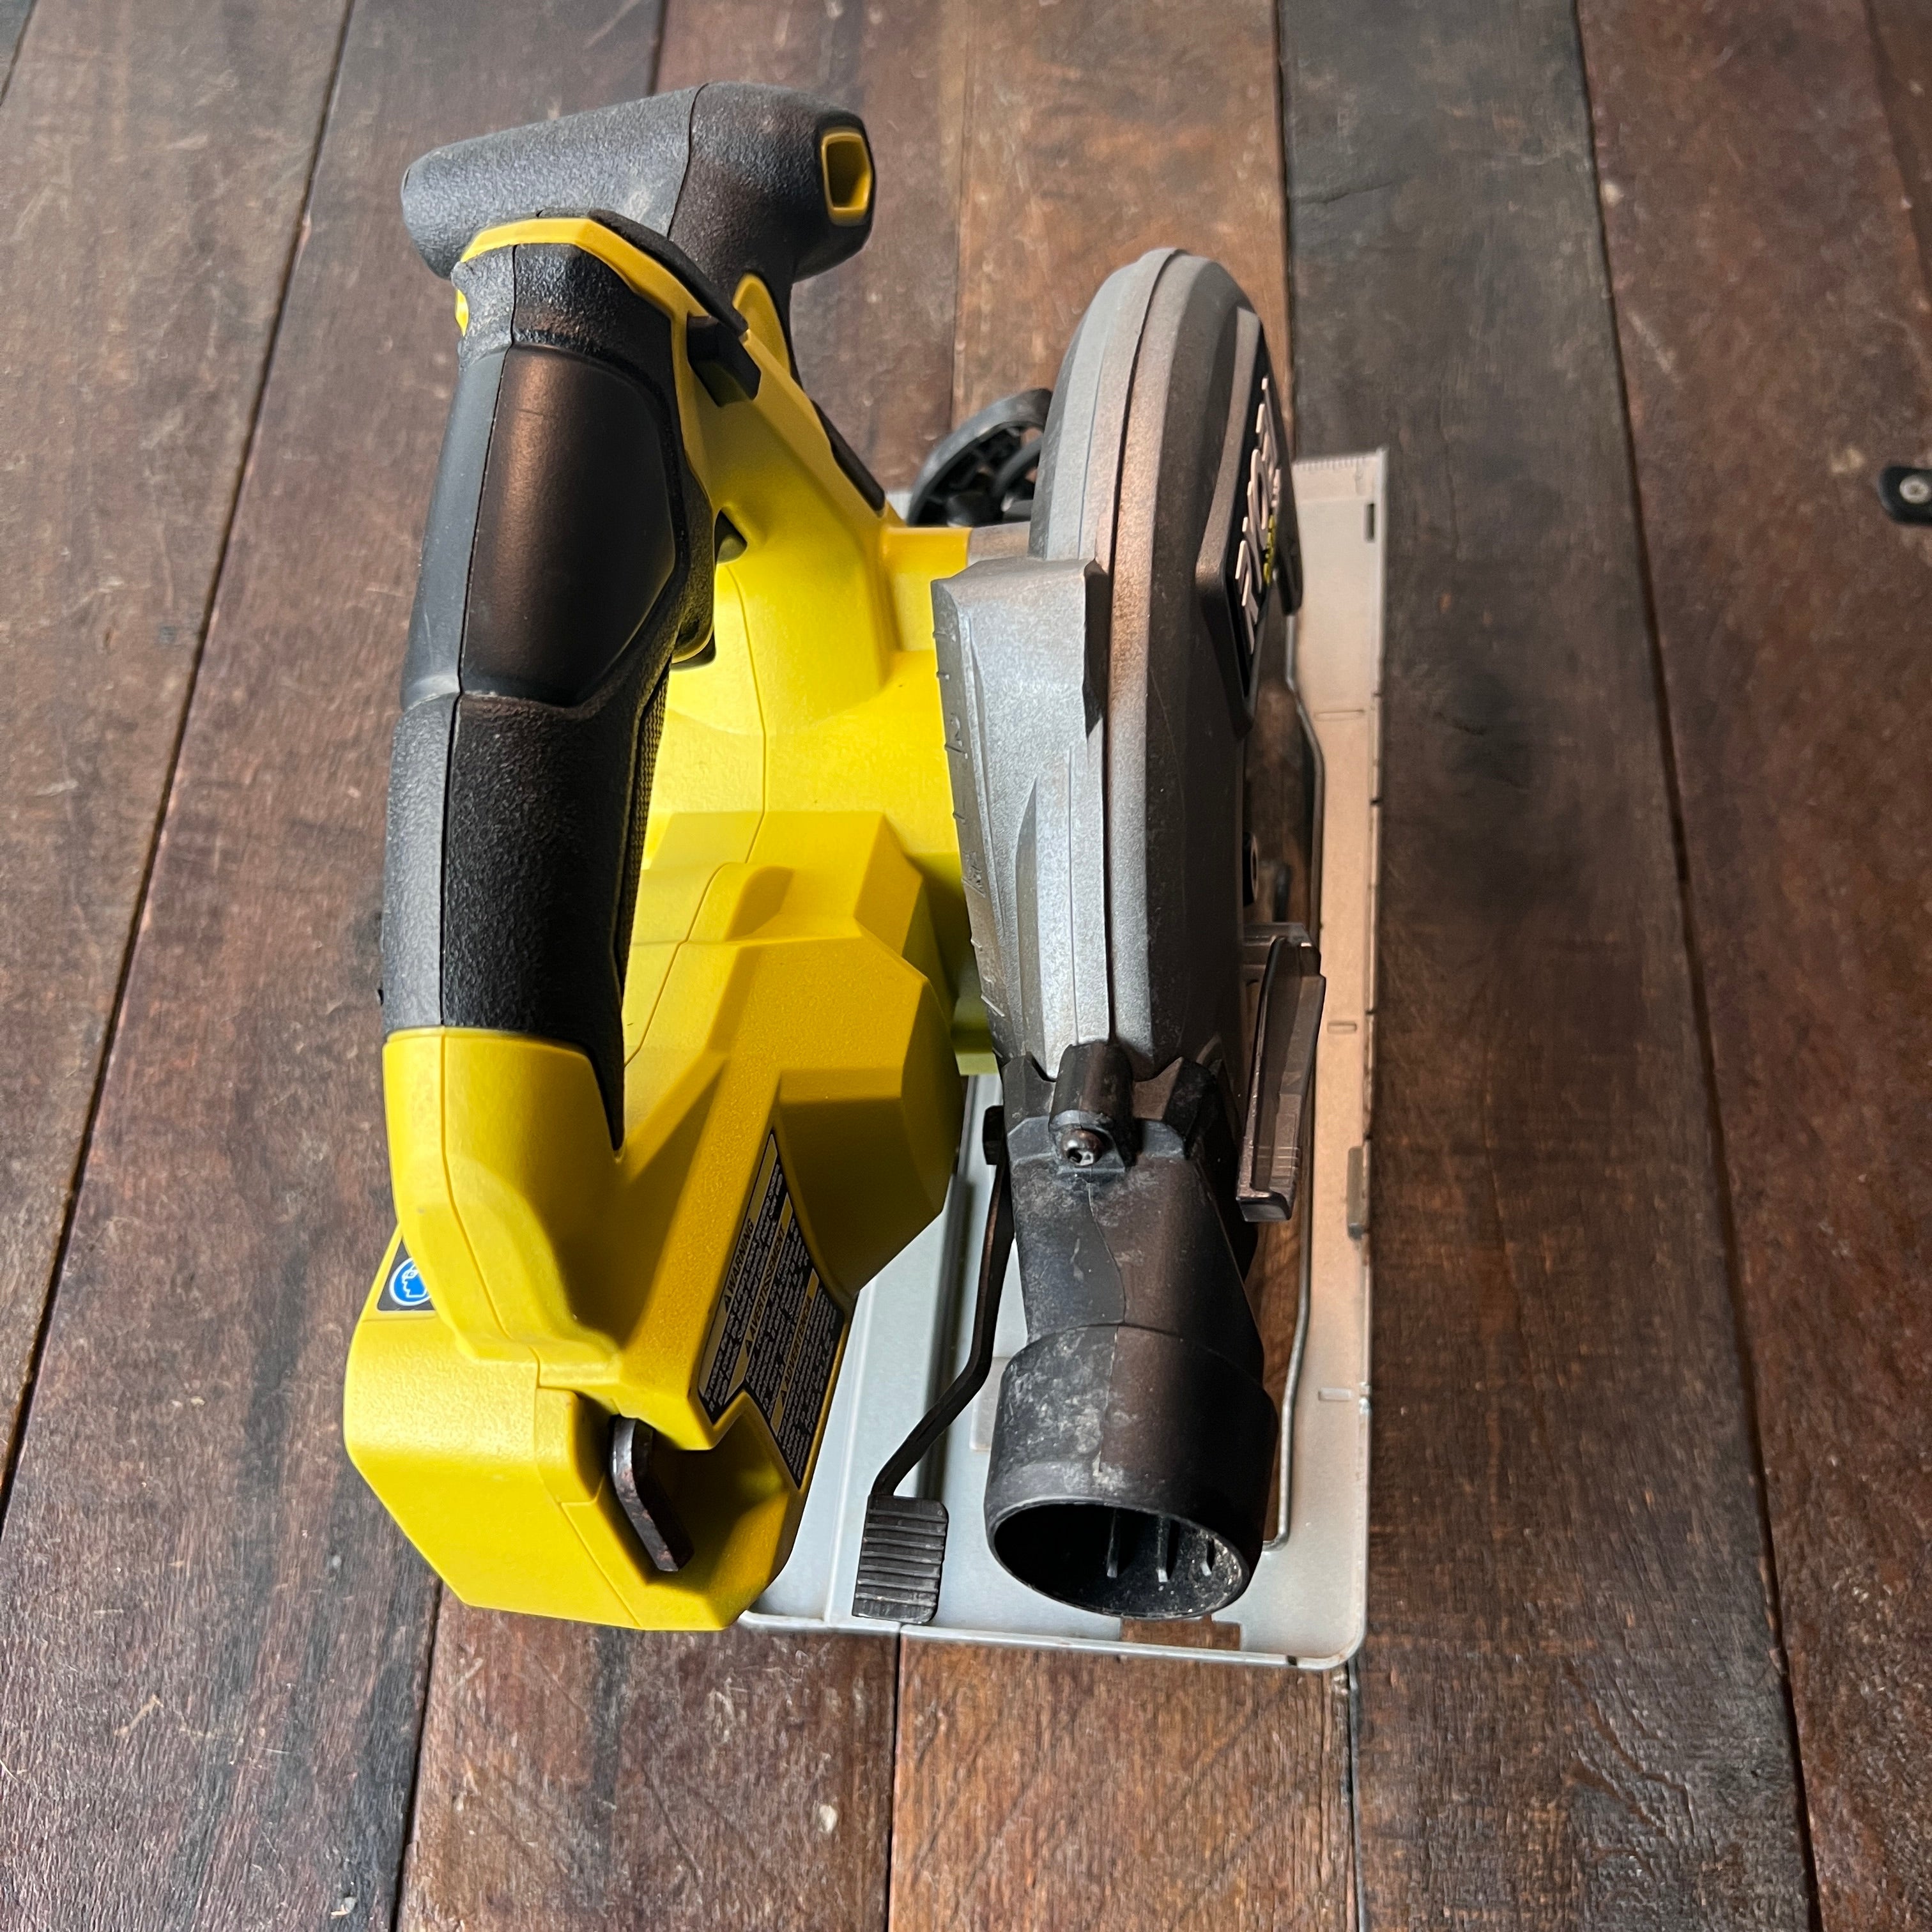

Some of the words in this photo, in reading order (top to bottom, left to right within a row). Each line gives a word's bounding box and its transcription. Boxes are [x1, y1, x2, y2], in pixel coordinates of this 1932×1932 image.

[727, 1218, 754, 1291] WARNING
[749, 1222, 786, 1340] AVERTISSEMENT
[784, 1295, 812, 1385] ADVERTENCIA
